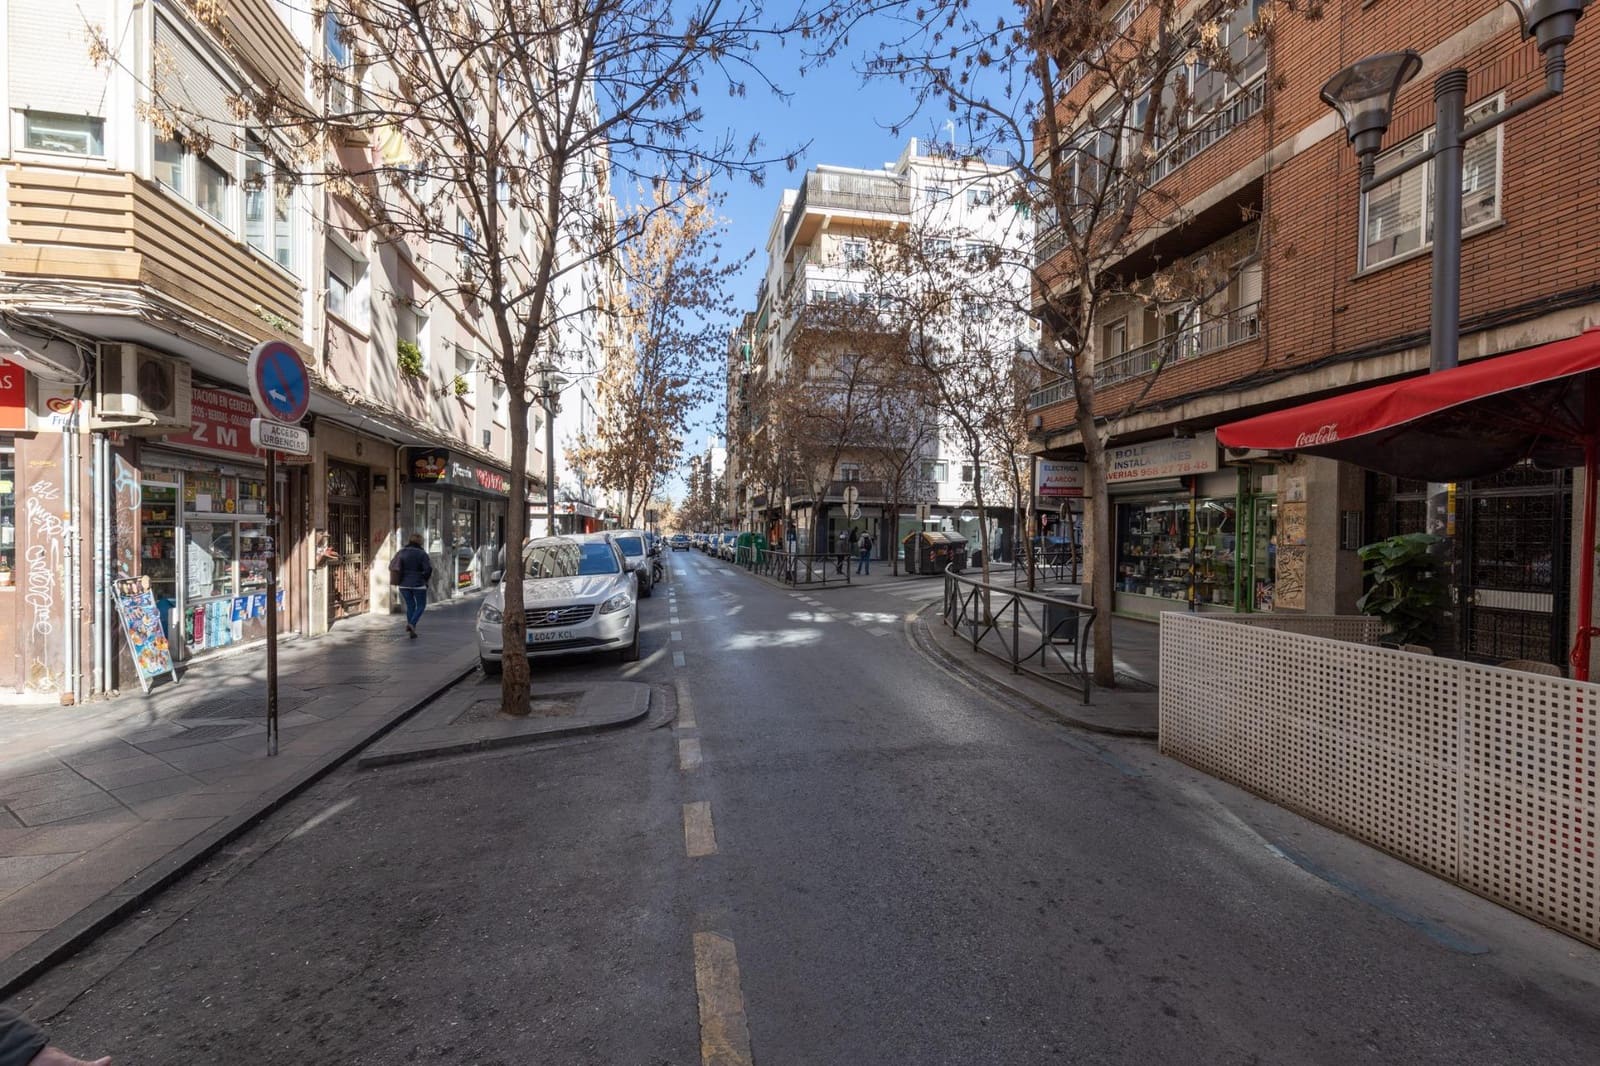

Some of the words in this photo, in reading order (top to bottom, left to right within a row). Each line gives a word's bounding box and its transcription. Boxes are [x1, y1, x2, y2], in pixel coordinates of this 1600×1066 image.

[219, 394, 228, 409] EN
[229, 397, 255, 415] GENERAL
[193, 421, 208, 442] Z
[216, 425, 238, 447] M
[272, 426, 299, 439] ACCESO
[264, 434, 305, 449] URGENCIAS
[1114, 450, 1192, 470] INSTALAIONES
[1140, 468, 1159, 477] 958
[1161, 465, 1174, 474] 27
[1177, 462, 1191, 472] 78
[1193, 460, 1209, 470] 48
[534, 631, 556, 641] 4047
